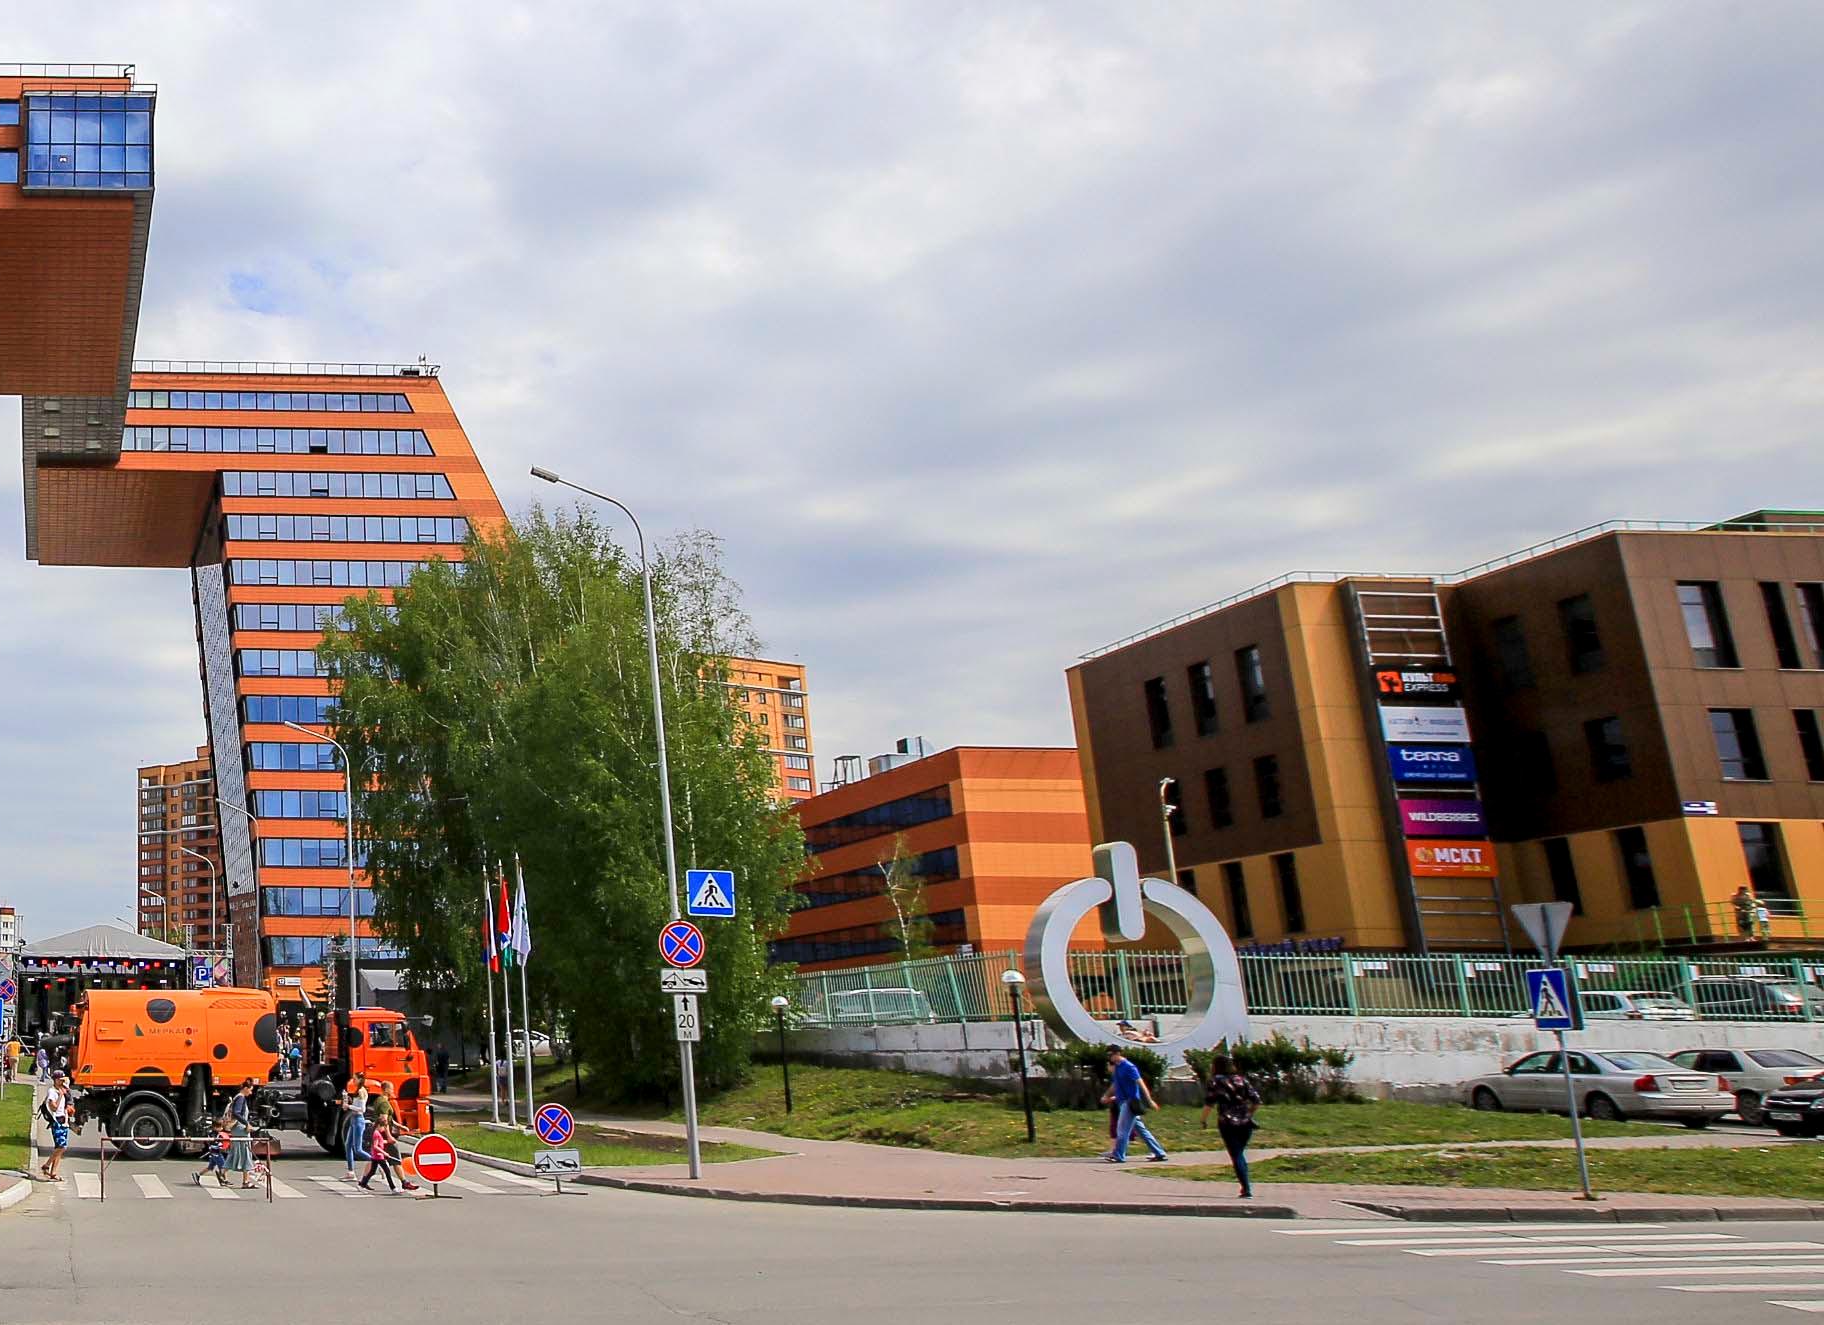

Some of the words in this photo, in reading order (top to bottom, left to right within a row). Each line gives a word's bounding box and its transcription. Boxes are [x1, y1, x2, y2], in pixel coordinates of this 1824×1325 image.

[1403, 684, 1449, 692] EXPRESS
[1407, 812, 1480, 822] WILDBERRIES
[198, 968, 207, 980] P
[678, 1014, 695, 1029] 20
